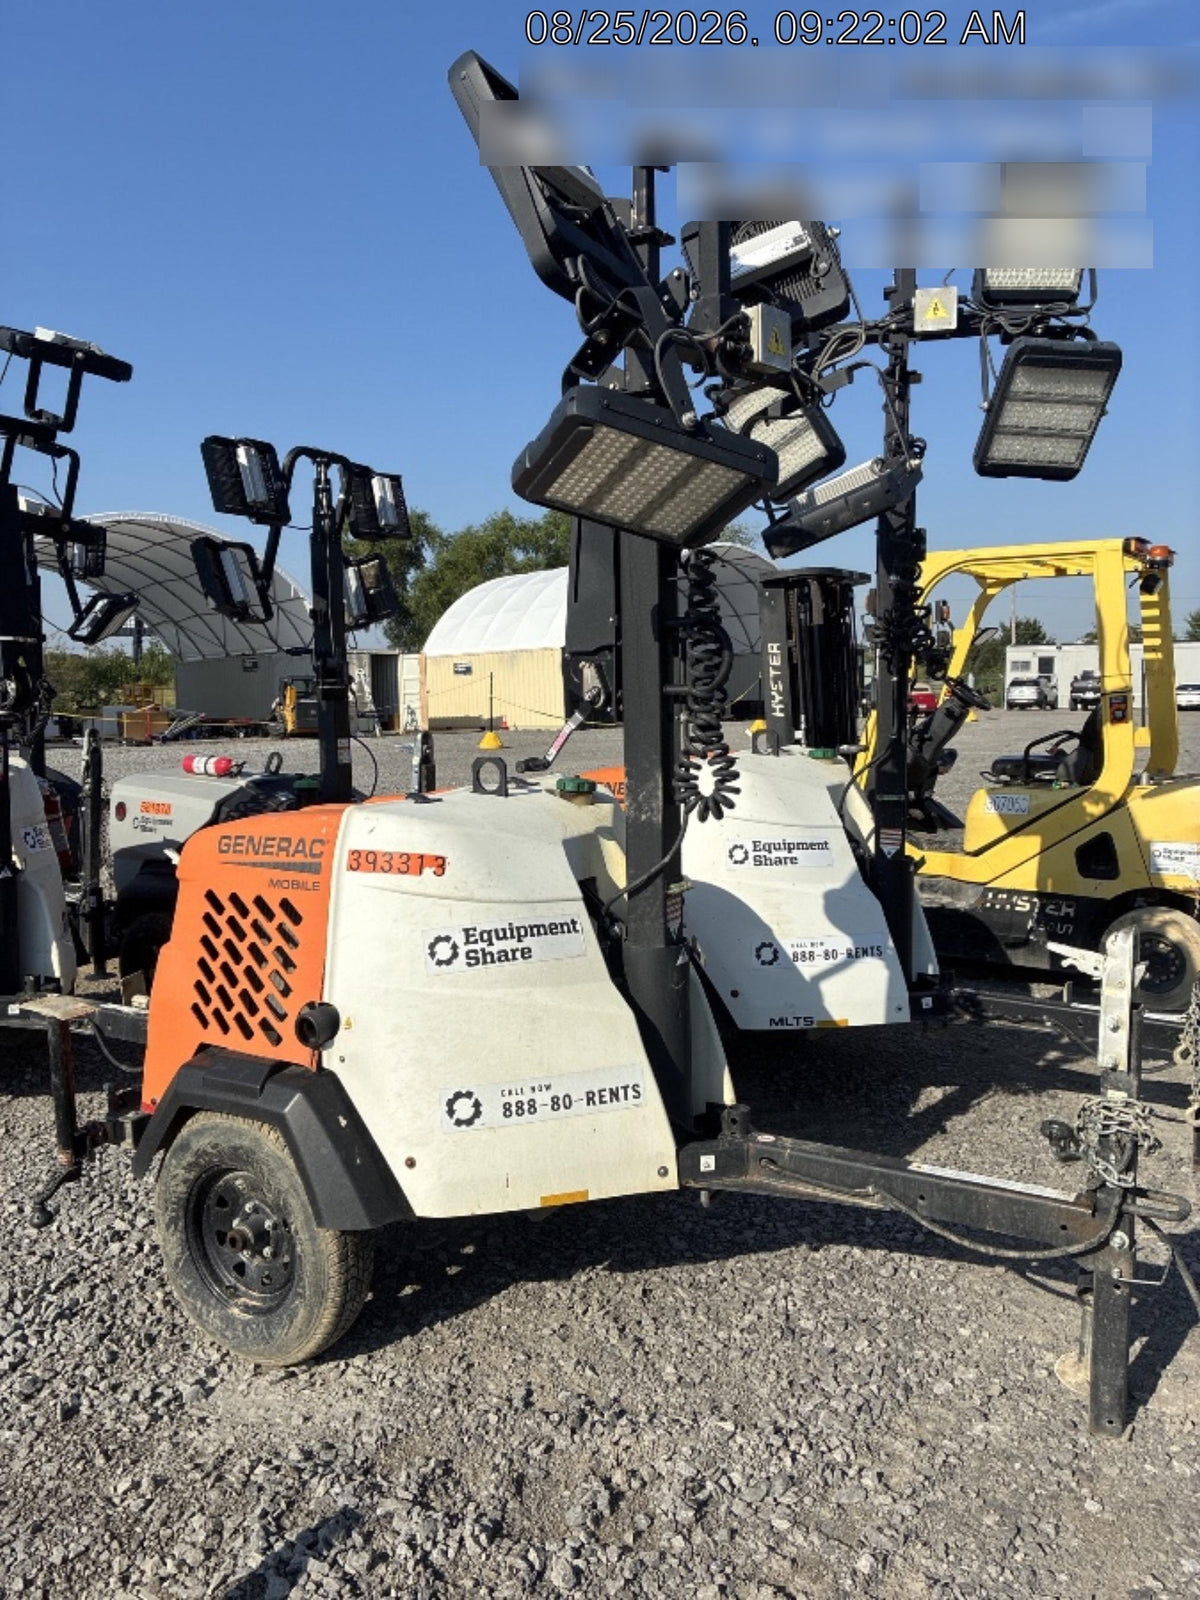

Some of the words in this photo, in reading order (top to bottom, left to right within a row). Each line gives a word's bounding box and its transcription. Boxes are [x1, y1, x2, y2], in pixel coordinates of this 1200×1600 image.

[767, 642, 785, 717] HYSTER
[218, 835, 325, 859] GENERAC
[752, 839, 830, 854] Equipment
[349, 850, 446, 877] 393313
[753, 854, 799, 866] Share
[268, 878, 320, 891] MOBILE
[462, 918, 580, 946] Equipment
[465, 946, 532, 967] Share
[792, 945, 883, 962] 888-80-RENTS
[769, 1016, 815, 1027] MLTS
[501, 1088, 525, 1097] CALL
[530, 1083, 552, 1094] NOW
[502, 1083, 642, 1119] 888-80-RENTS
